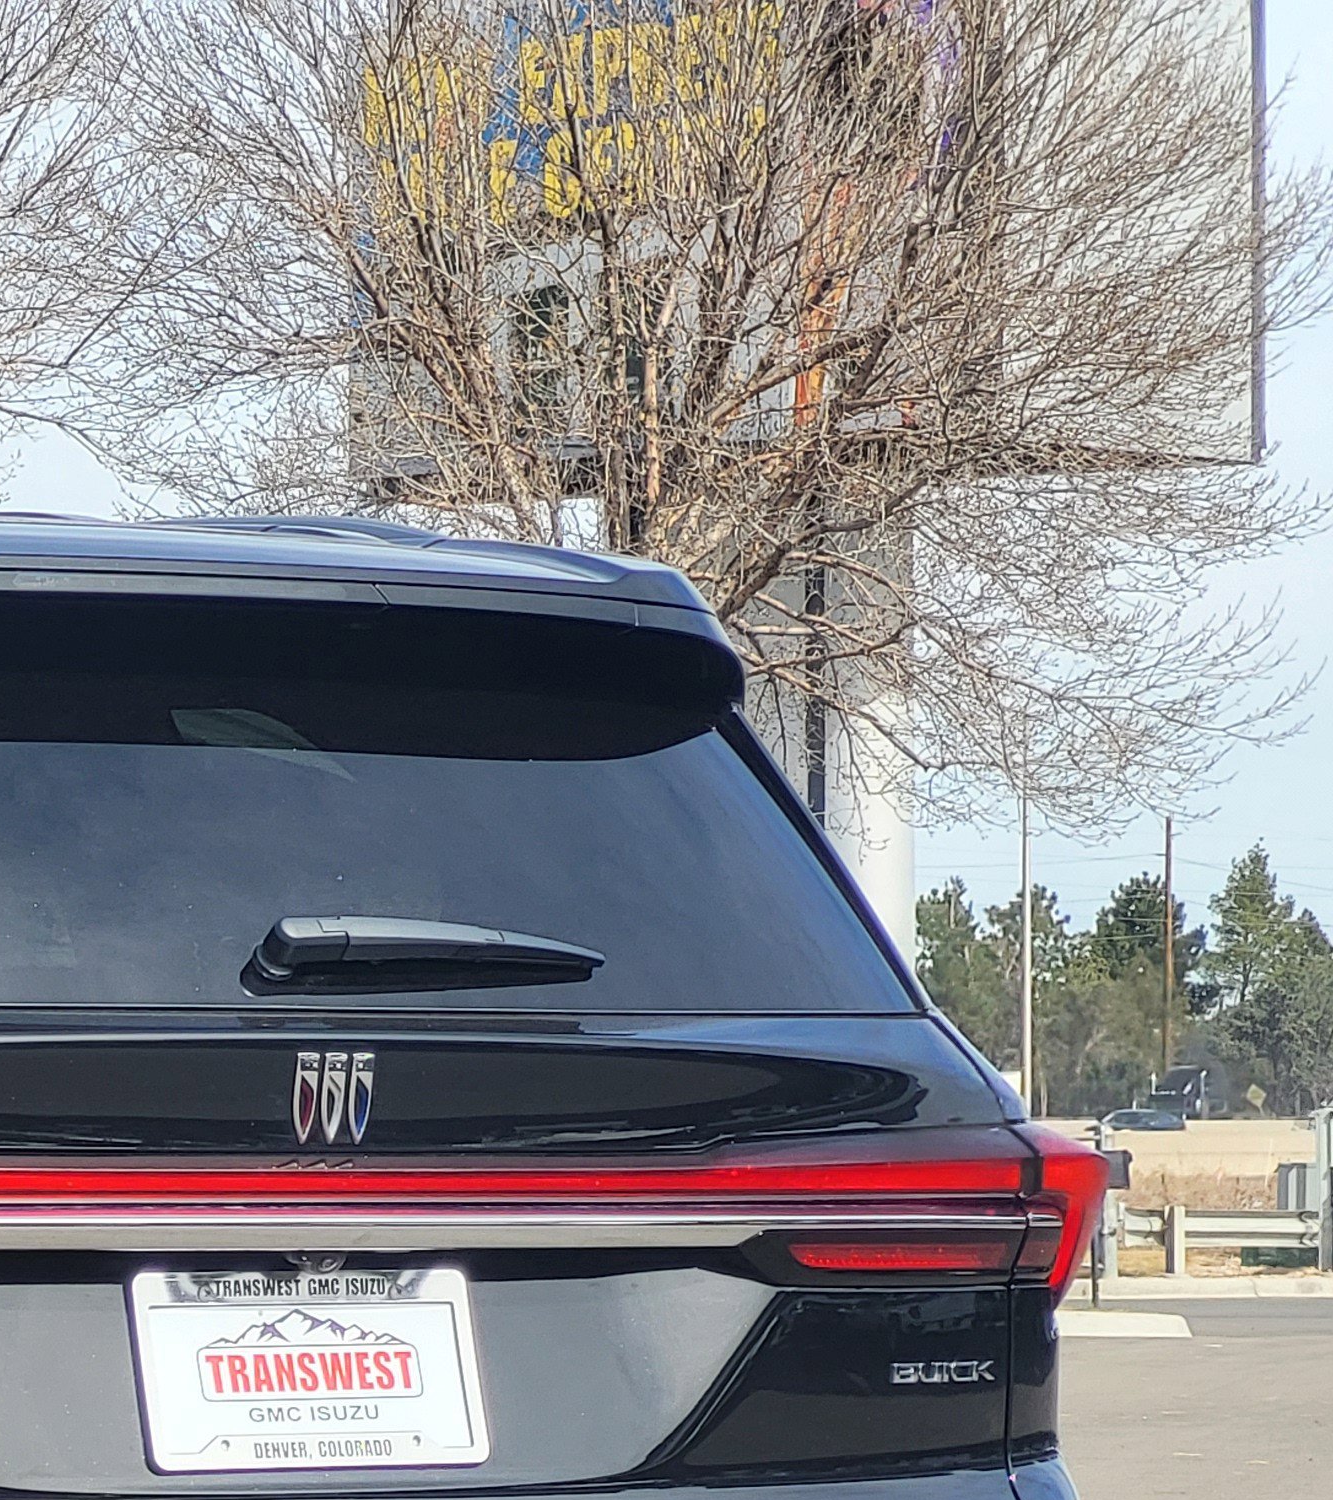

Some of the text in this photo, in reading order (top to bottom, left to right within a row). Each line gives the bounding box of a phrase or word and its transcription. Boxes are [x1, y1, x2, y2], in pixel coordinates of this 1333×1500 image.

[215, 1277, 386, 1298] TRANSWEST GMC ISUZU
[204, 1351, 414, 1394] TRANSWEST
[890, 1361, 996, 1383] BUICK
[248, 1404, 379, 1423] GMC ISUZU
[254, 1439, 393, 1460] DENVER, COLORADO
